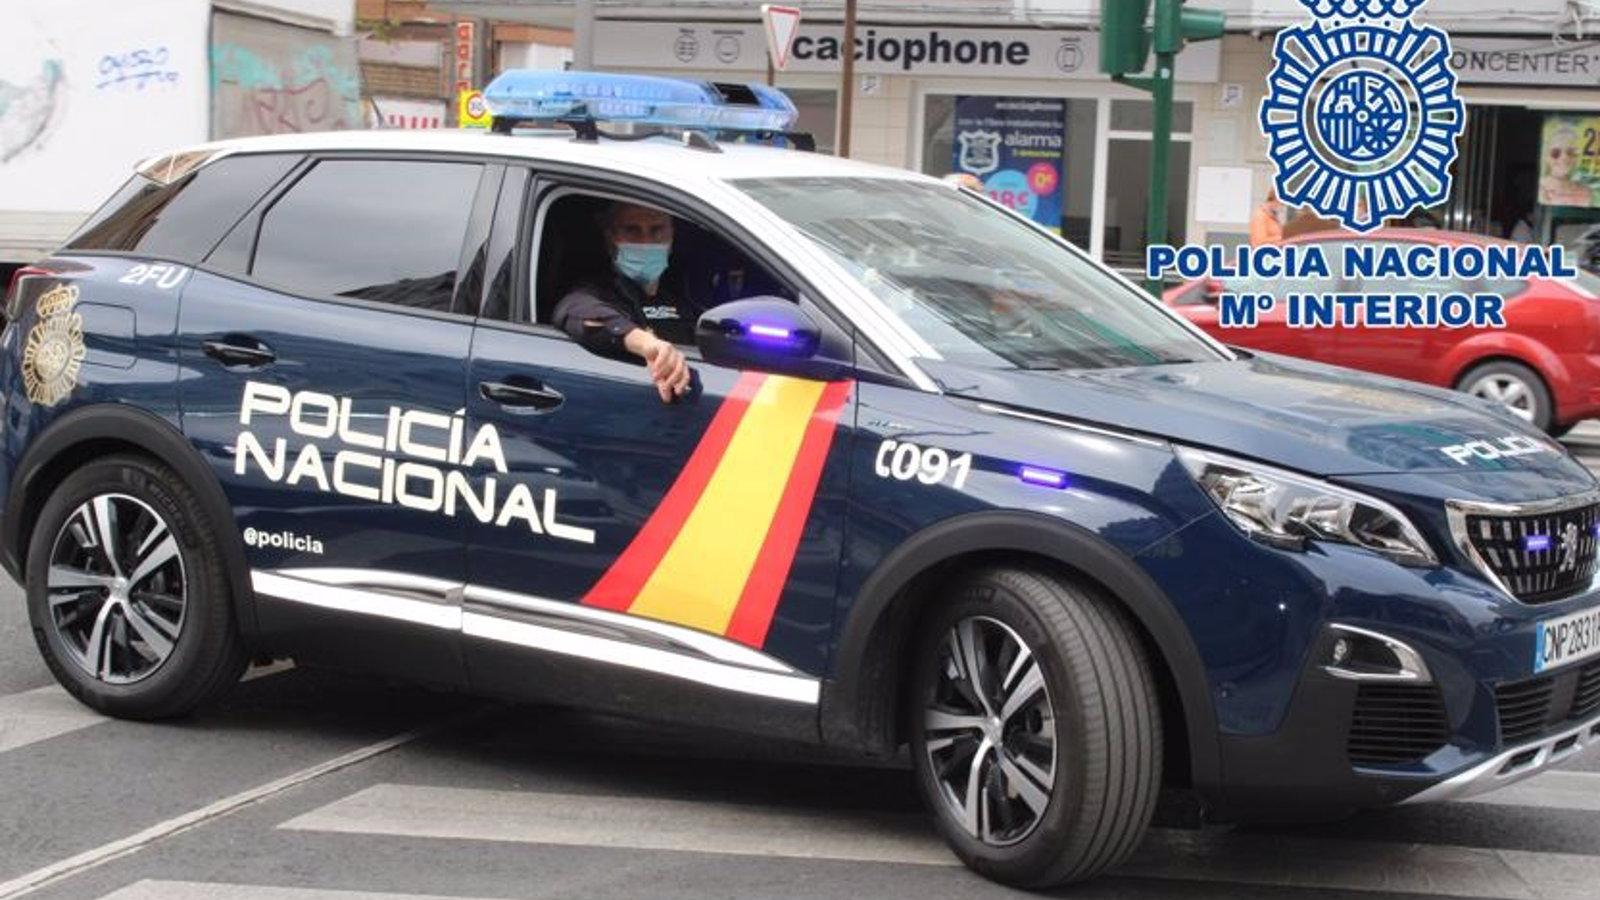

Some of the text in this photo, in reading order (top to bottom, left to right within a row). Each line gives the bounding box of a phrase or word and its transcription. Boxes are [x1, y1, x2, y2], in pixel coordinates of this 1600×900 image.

[1004, 131, 1062, 148] alarma
[118, 263, 189, 289] 2FU
[240, 380, 508, 474] POLICÍA
[234, 430, 596, 544] NACIONAL
[243, 527, 324, 555] @policia
